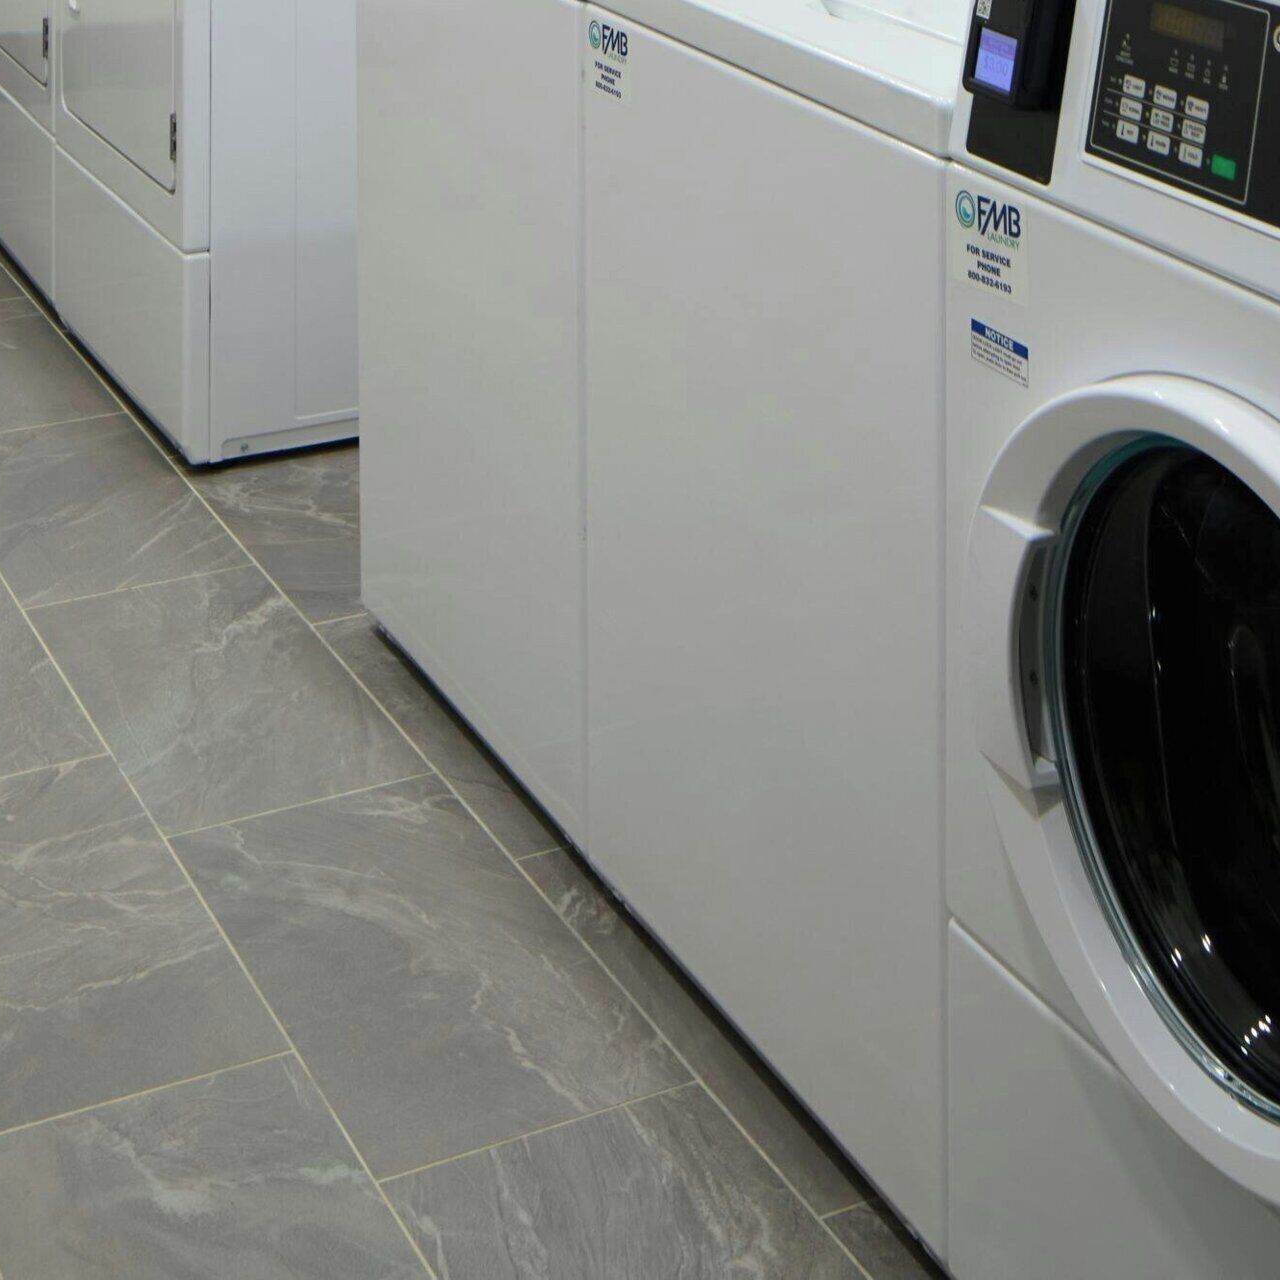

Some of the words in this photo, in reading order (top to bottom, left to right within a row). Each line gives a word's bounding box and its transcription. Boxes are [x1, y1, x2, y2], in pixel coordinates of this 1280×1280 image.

[602, 24, 628, 56] FMB
[977, 195, 1021, 239] FMB
[987, 231, 1020, 251] LAUNDRY
[966, 243, 981, 257] FOR
[982, 249, 1012, 268] SERVICE
[977, 260, 1001, 277] PHONE
[985, 327, 1014, 352] NOTICE
